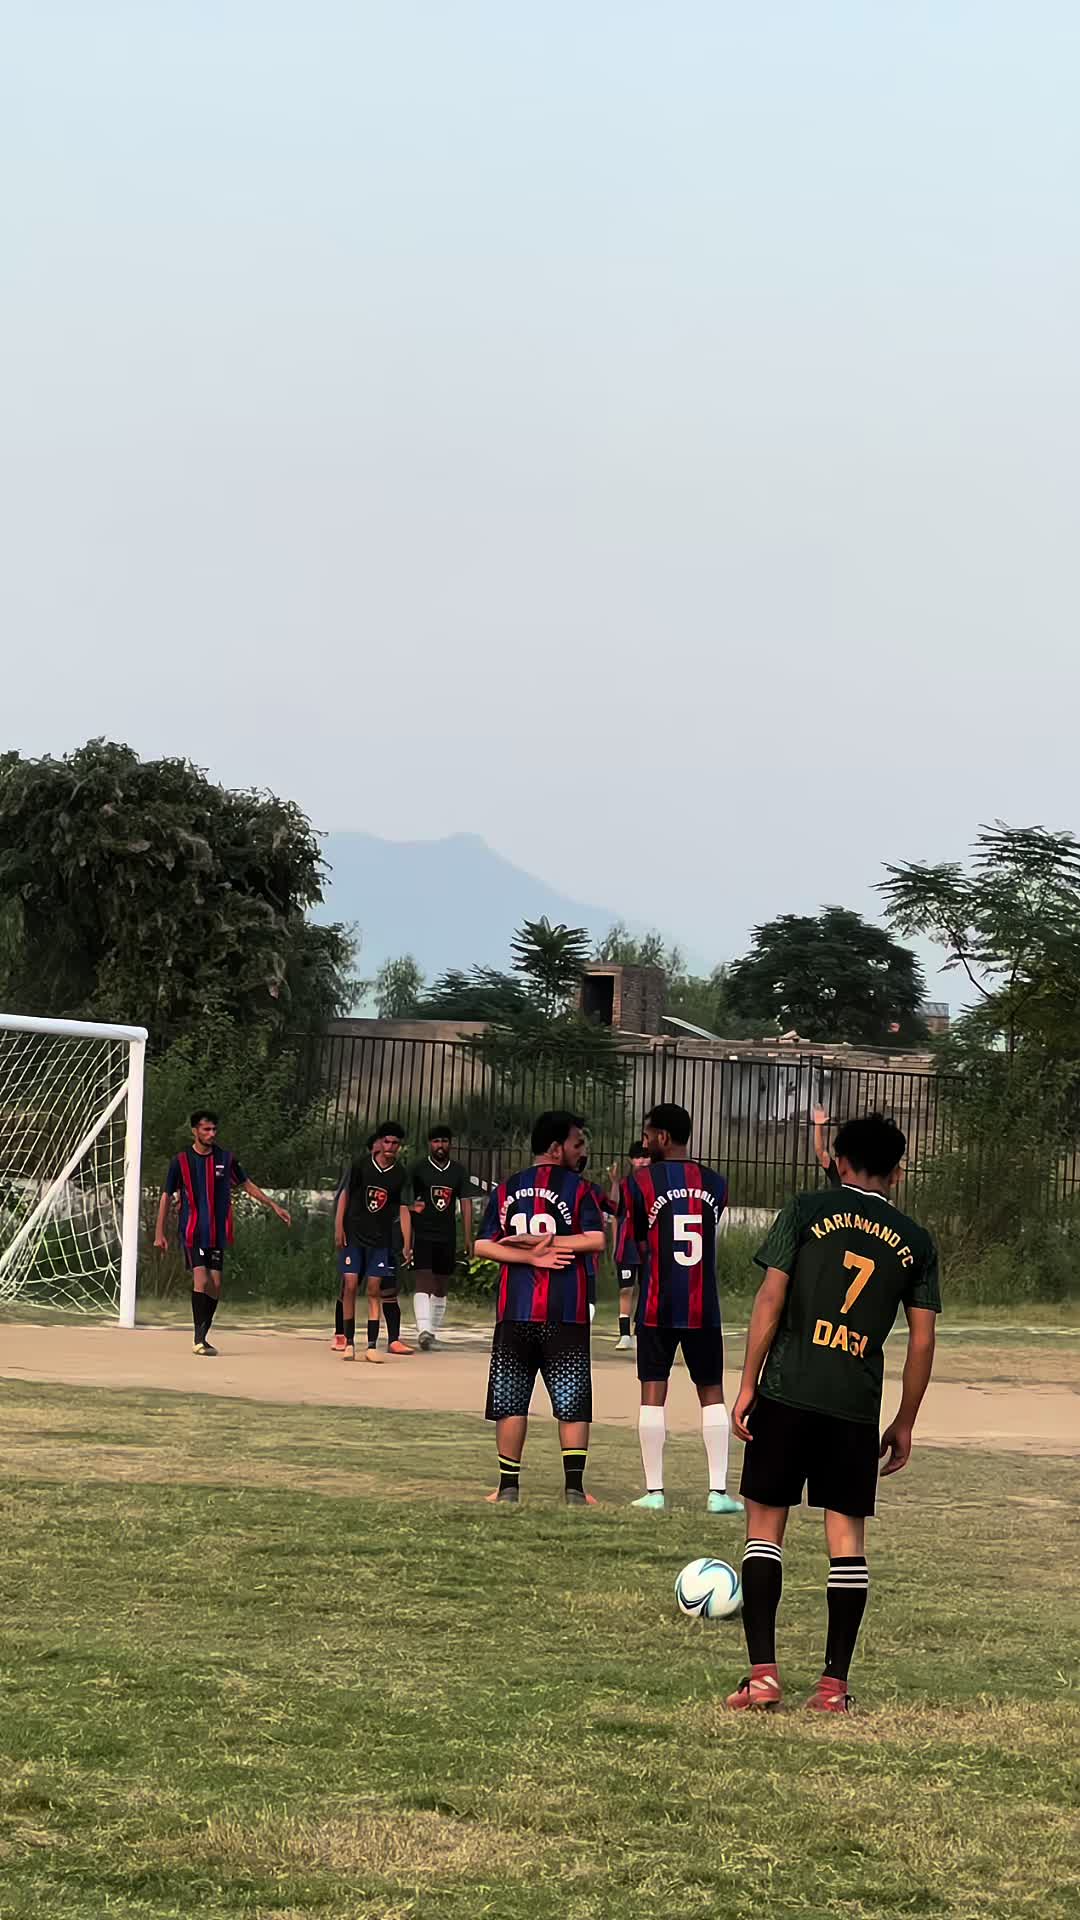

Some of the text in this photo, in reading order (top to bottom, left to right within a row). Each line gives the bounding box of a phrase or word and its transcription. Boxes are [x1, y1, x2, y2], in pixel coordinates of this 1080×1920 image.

[666, 1187, 715, 1207] FOOTBALL
[673, 1214, 703, 1267] 5
[896, 1245, 914, 1268] FC
[840, 1250, 876, 1315] 7
